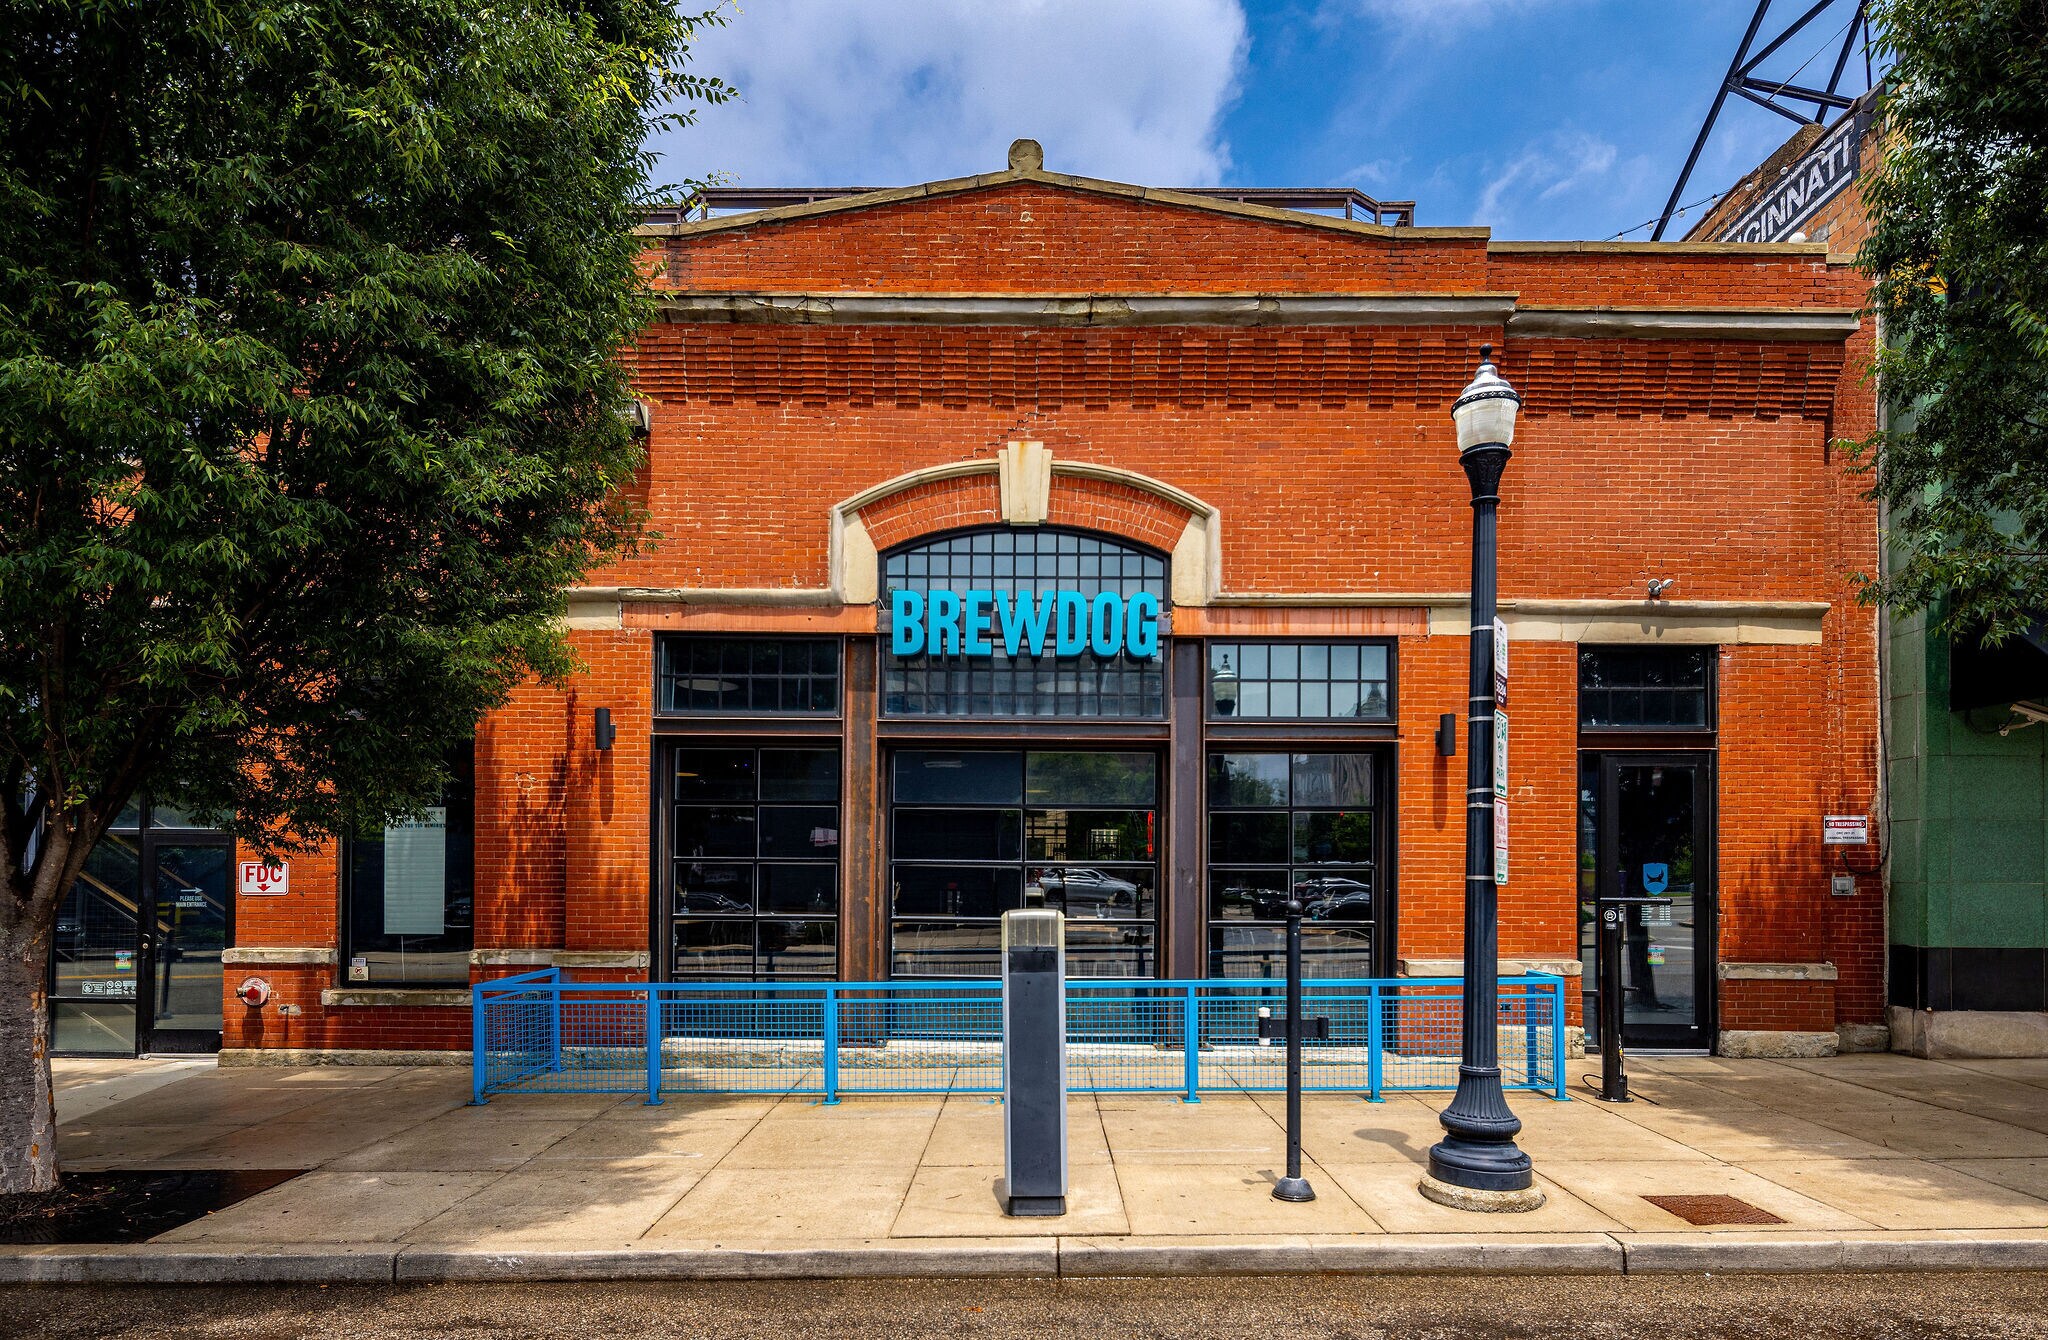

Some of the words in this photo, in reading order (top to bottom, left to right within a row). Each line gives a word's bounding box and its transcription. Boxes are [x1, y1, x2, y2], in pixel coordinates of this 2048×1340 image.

[1737, 134, 1850, 243] CINNATI
[892, 590, 1159, 658] BREWDOG
[245, 865, 283, 883] FDC
